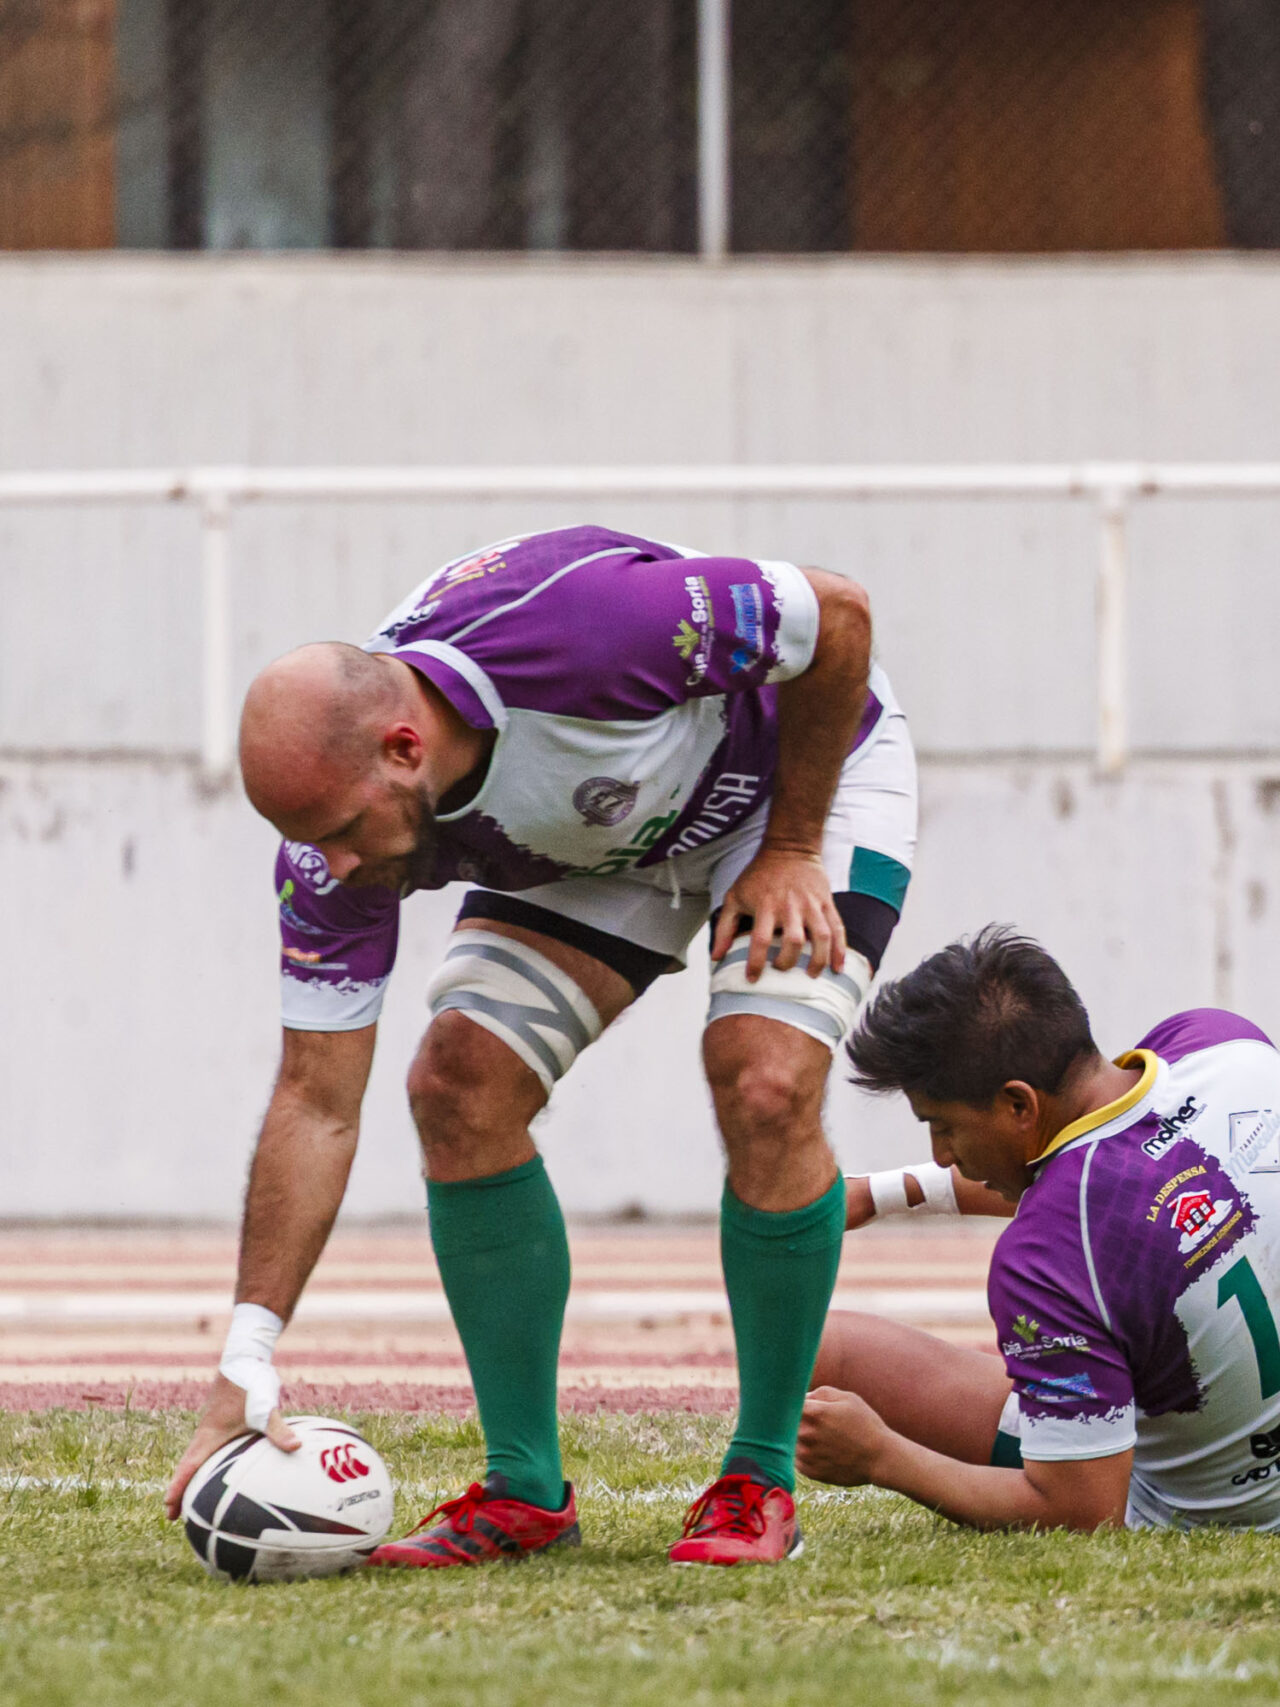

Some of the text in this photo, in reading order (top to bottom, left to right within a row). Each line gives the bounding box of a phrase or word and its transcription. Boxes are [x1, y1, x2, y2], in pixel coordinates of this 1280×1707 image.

[1146, 1205, 1160, 1223] LA
[1154, 1164, 1208, 1205] DESPENSA
[1040, 1332, 1088, 1349] Soria
